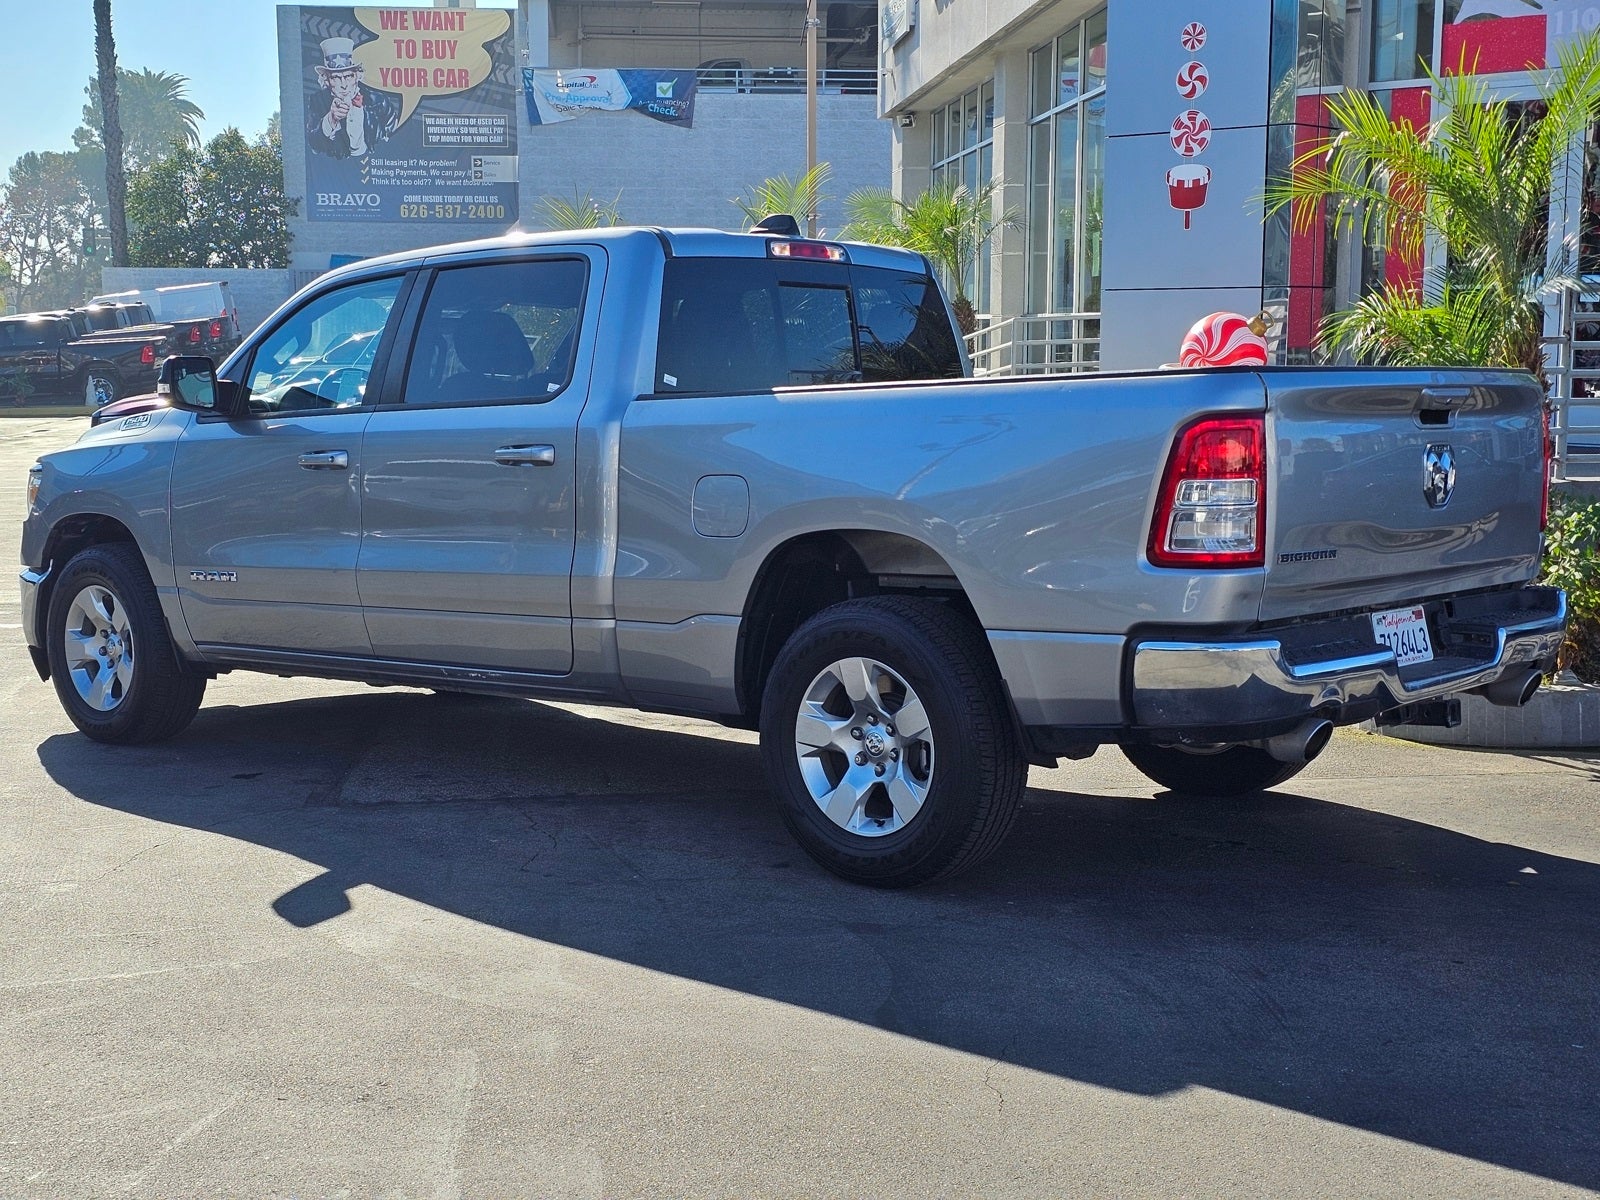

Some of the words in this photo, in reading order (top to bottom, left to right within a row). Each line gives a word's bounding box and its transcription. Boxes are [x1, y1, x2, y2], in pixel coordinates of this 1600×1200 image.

[379, 10, 409, 31] WE
[412, 11, 467, 31] WANT
[393, 39, 417, 60] TO
[421, 39, 458, 60] BUY
[379, 67, 428, 88] YOUR
[433, 68, 470, 88] CAR
[648, 103, 679, 117] Check.
[460, 126, 469, 134] SO
[428, 135, 440, 143] TOP
[440, 135, 460, 143] MONEY
[461, 135, 473, 143] FOR
[473, 135, 489, 143] YOUR
[371, 158, 384, 166] Still
[384, 158, 408, 168] leasing
[429, 159, 458, 168] problem!
[371, 168, 395, 177] Making
[453, 170, 466, 178] pay
[371, 178, 389, 186] Think
[390, 178, 401, 186] it's
[401, 178, 413, 186] too
[413, 178, 432, 186] old??
[434, 178, 446, 186] We
[315, 193, 381, 207] BRAVO
[403, 195, 422, 203] COME
[422, 195, 443, 203] INSIDE
[444, 195, 463, 203] TODAY
[464, 195, 474, 203] OR
[474, 195, 489, 203] CALL
[490, 195, 499, 203] US
[400, 204, 505, 219] 626-537-2400
[190, 570, 238, 582] RAM
